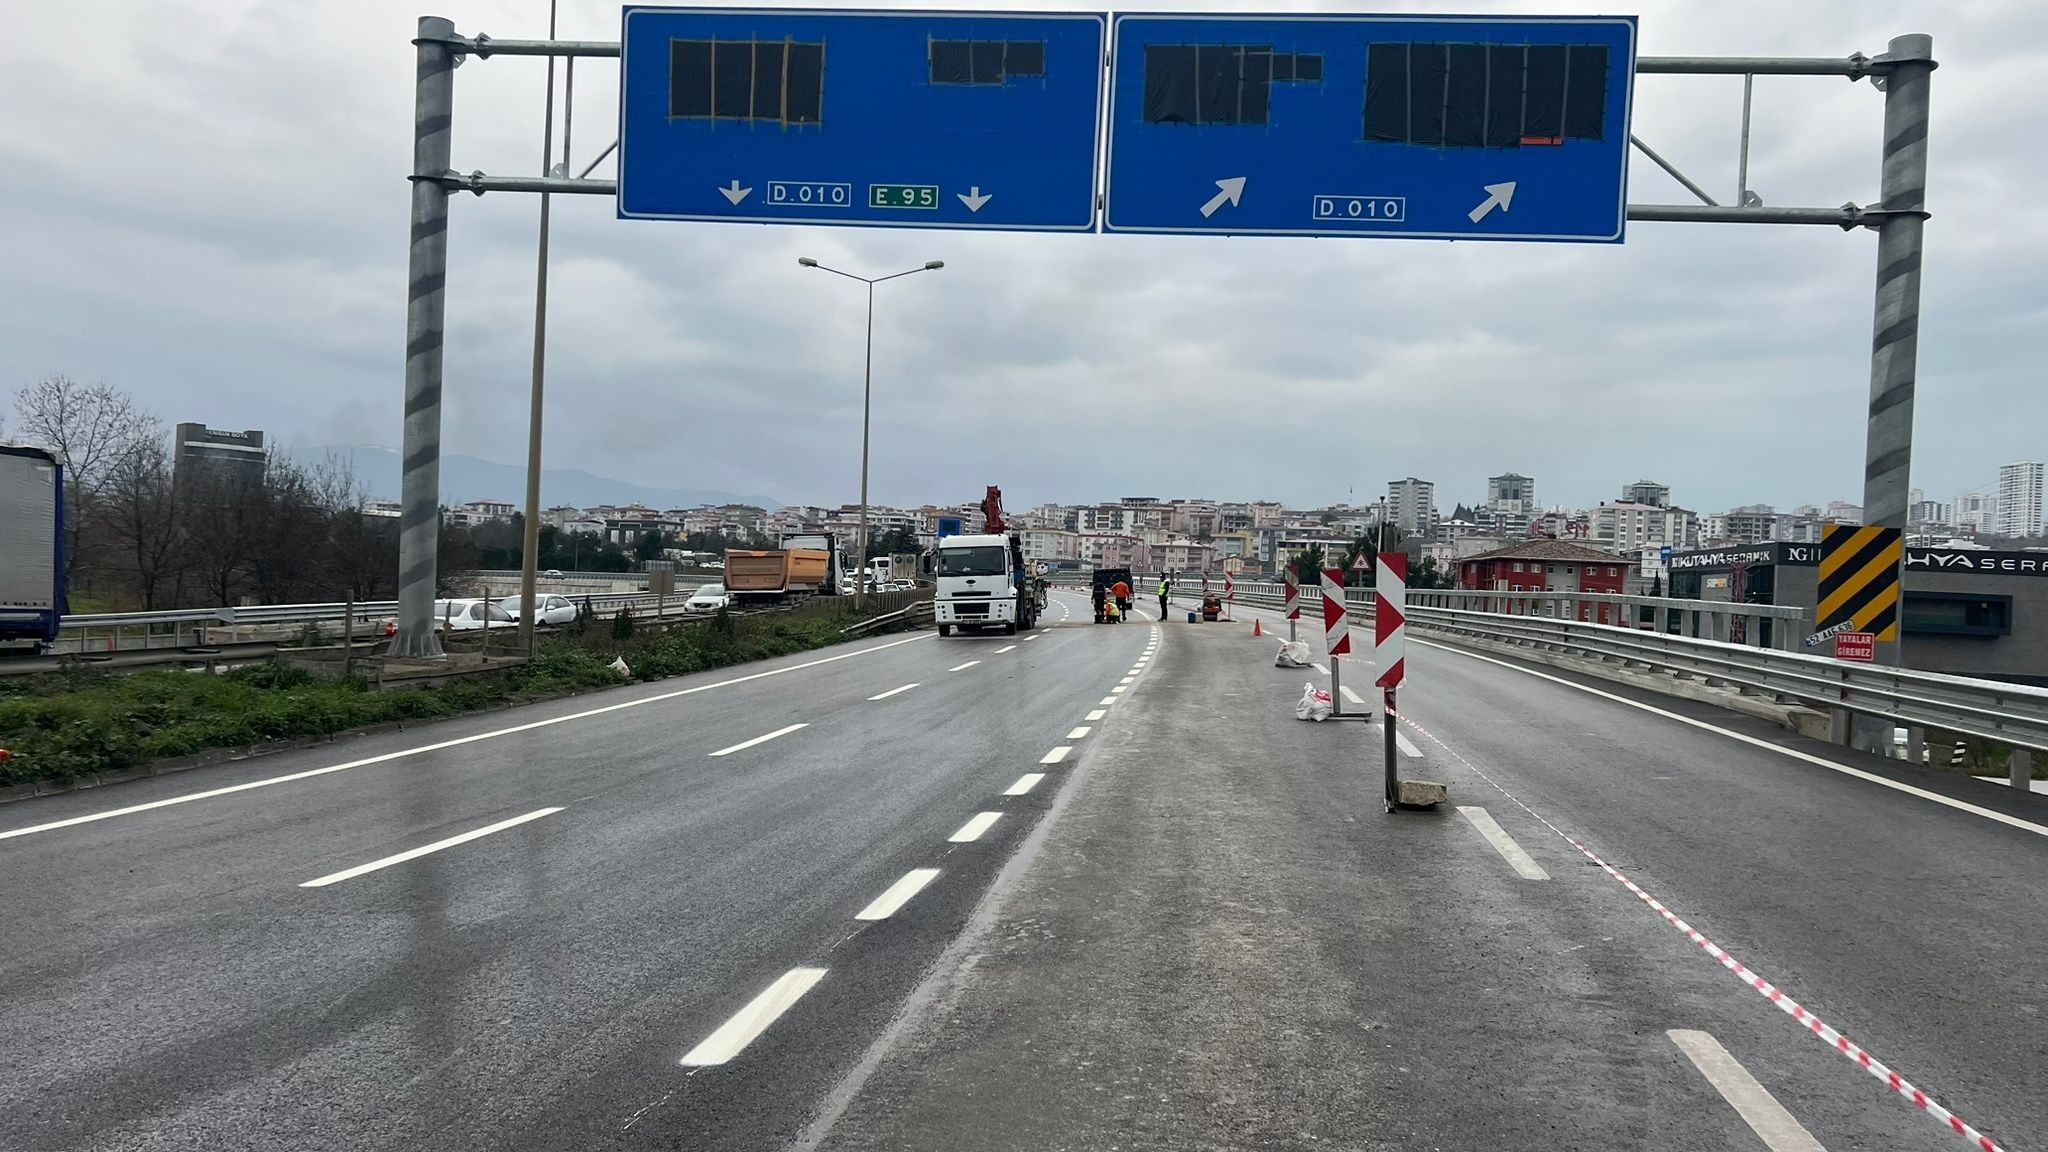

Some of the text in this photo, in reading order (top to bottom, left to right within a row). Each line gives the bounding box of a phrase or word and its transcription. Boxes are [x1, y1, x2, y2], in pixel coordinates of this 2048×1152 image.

[773, 184, 845, 203] D.010
[875, 187, 933, 206] E.95
[1320, 199, 1398, 218] D.010
[1810, 635, 1820, 644] 52
[1838, 634, 1872, 644] YAYALAR
